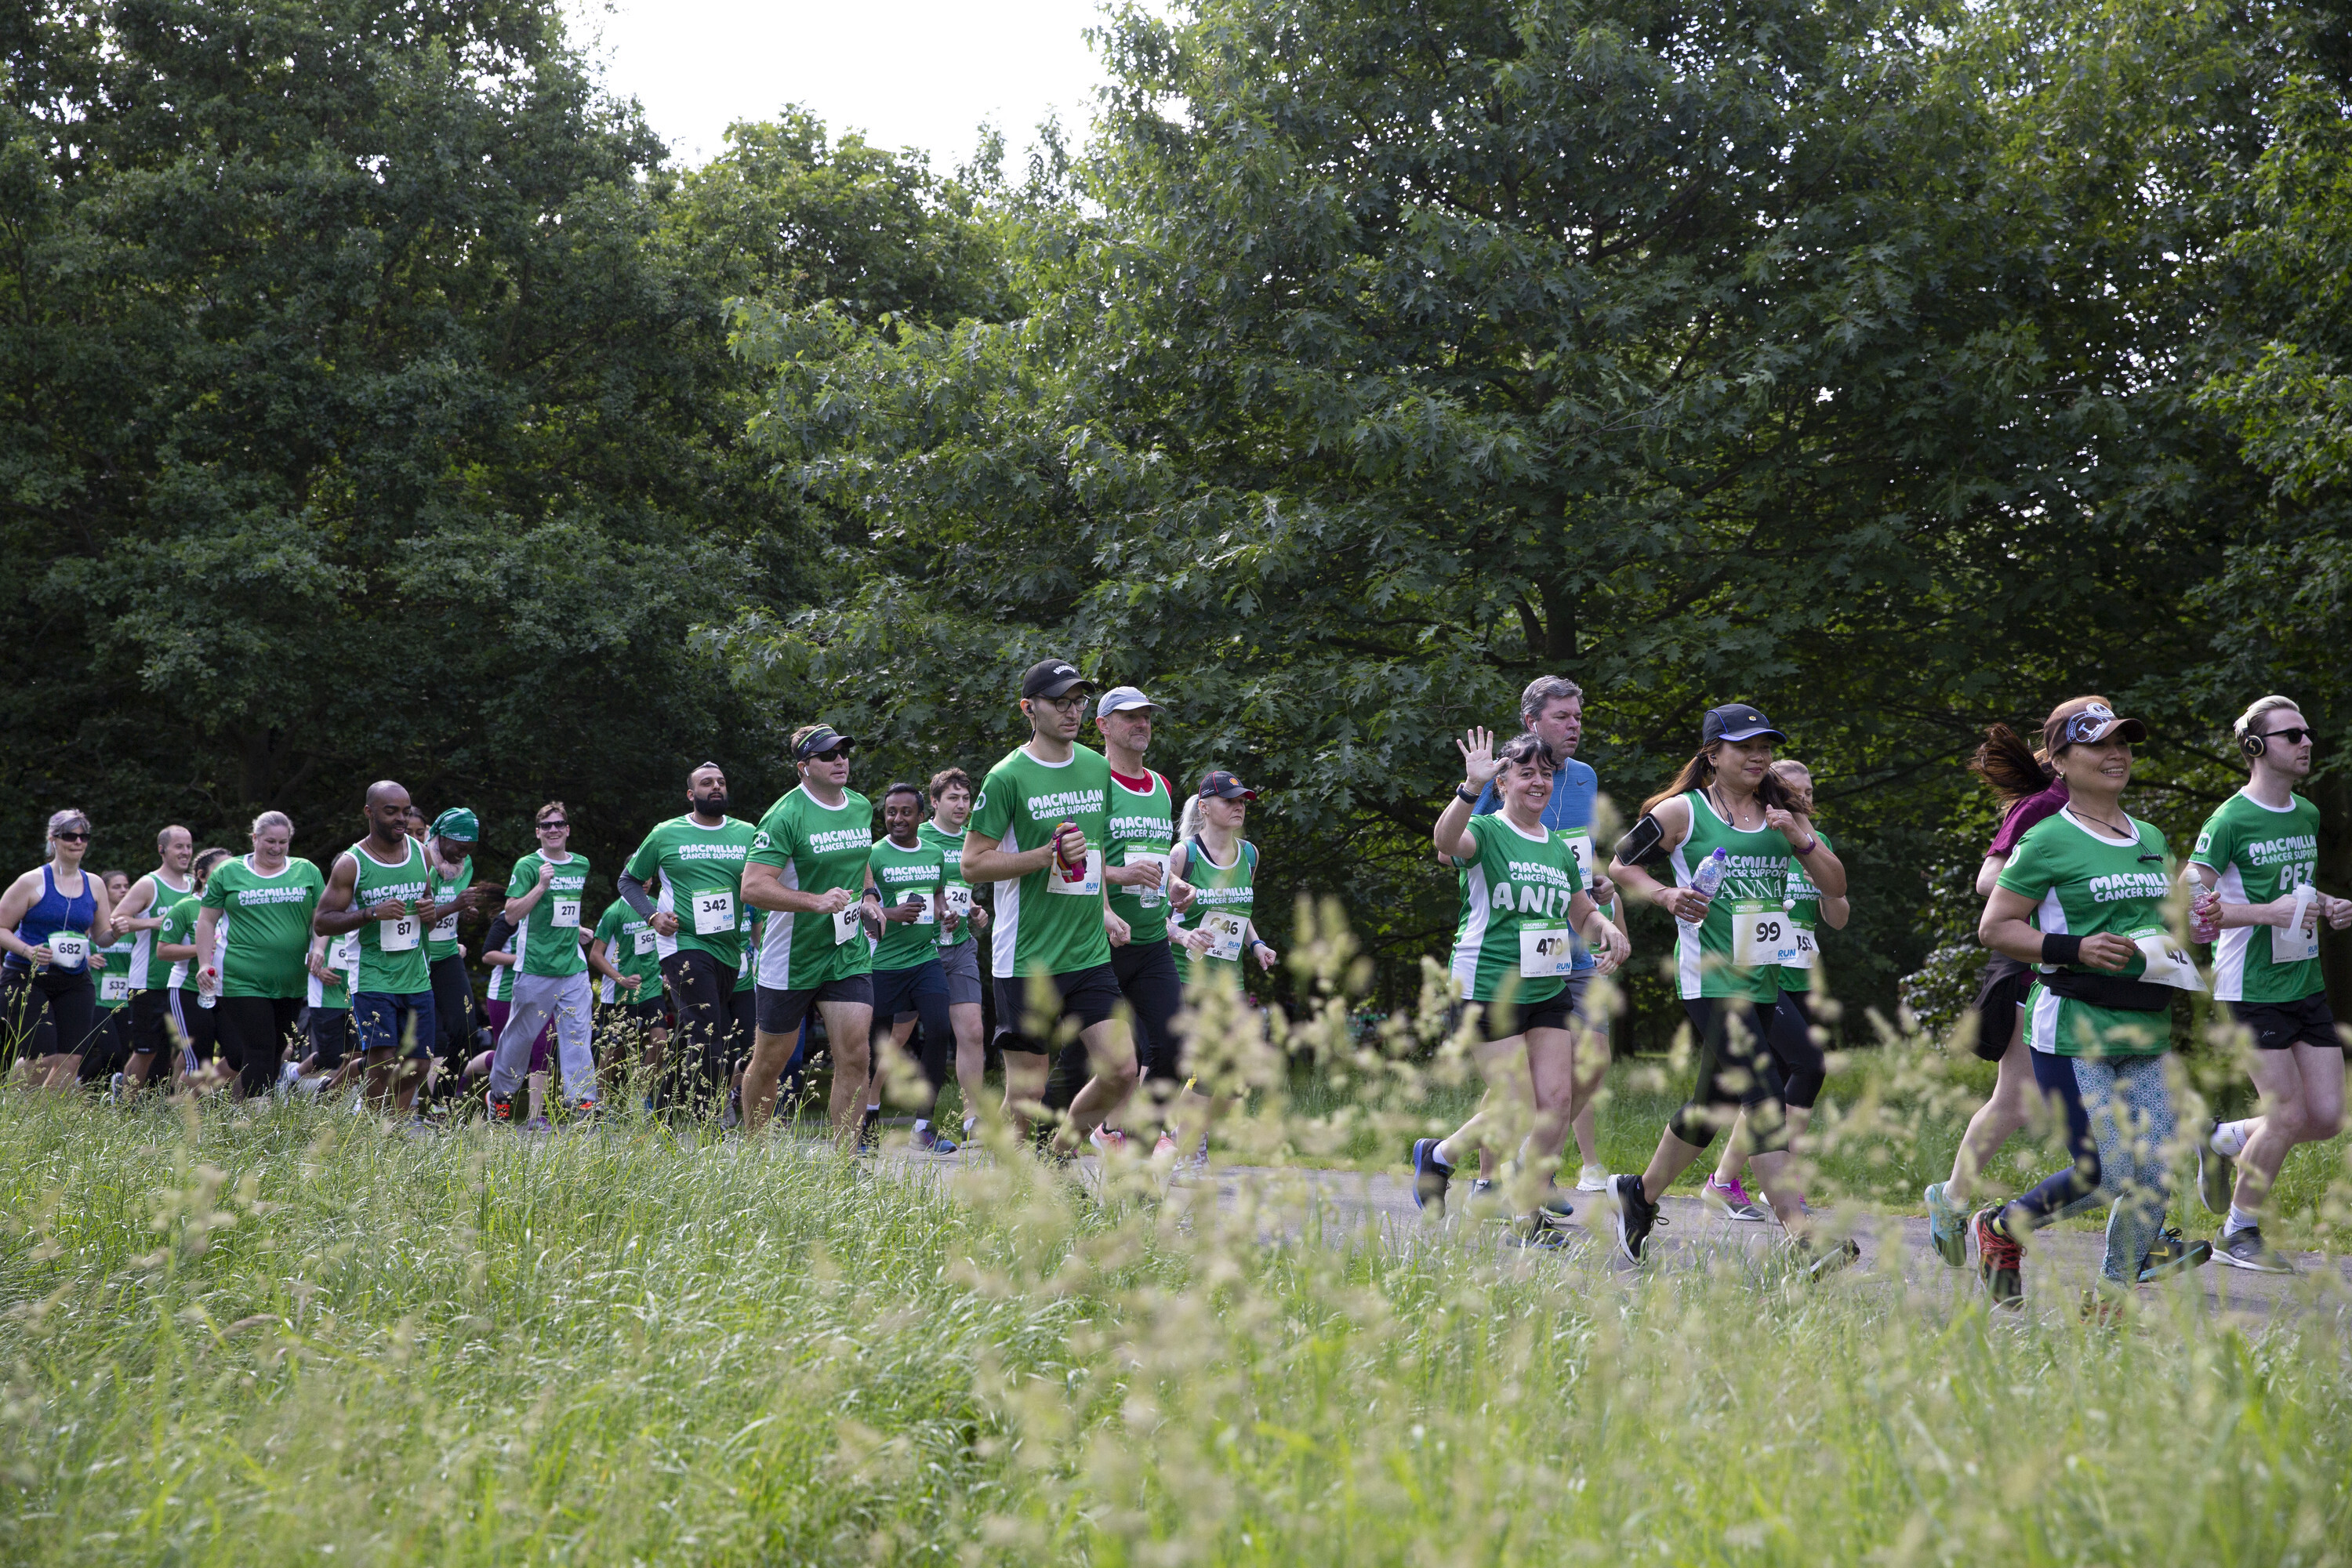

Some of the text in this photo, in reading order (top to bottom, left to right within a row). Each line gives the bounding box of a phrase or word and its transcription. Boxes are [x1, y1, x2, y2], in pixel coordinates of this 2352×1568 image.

[1028, 789, 1104, 811] MACMILLAN
[1032, 803, 1102, 820] CANCER SUPPORT
[1110, 816, 1173, 832] MACMILLA
[809, 828, 872, 846] MACMILLAN
[1112, 829, 1173, 840] CANCER SUPPOR
[679, 844, 746, 855] MACMILLAN
[813, 842, 845, 854] CANCER
[2249, 834, 2318, 858] MACMILLA
[1725, 855, 1790, 869] ACMILLA
[2252, 848, 2318, 866] CANCER SUPPOR
[883, 866, 941, 877] MACMILLAN
[1508, 861, 1568, 881] MACMILLA
[1725, 869, 1788, 878] NCER SUPPORT
[1788, 872, 1801, 882] RE
[1511, 872, 1546, 883] CANCER
[1547, 877, 1571, 890] SUPPOR
[2089, 873, 2171, 892] MACMILL
[238, 887, 307, 900] MACMILLAN
[1719, 878, 1783, 900] ANNA
[2094, 886, 2171, 902] CANCER SUPP
[239, 898, 270, 906] CANCER
[952, 891, 967, 903] 243
[1492, 883, 1571, 917] ANIT
[561, 906, 575, 916] 277
[702, 898, 727, 913] 342
[397, 922, 411, 935] 87
[436, 917, 453, 928] 250
[641, 933, 655, 944] 562
[1756, 922, 1780, 942] 99
[59, 943, 81, 954] 682
[339, 949, 347, 958] 6
[1537, 938, 1563, 956] 479
[1778, 949, 1795, 957] RUN
